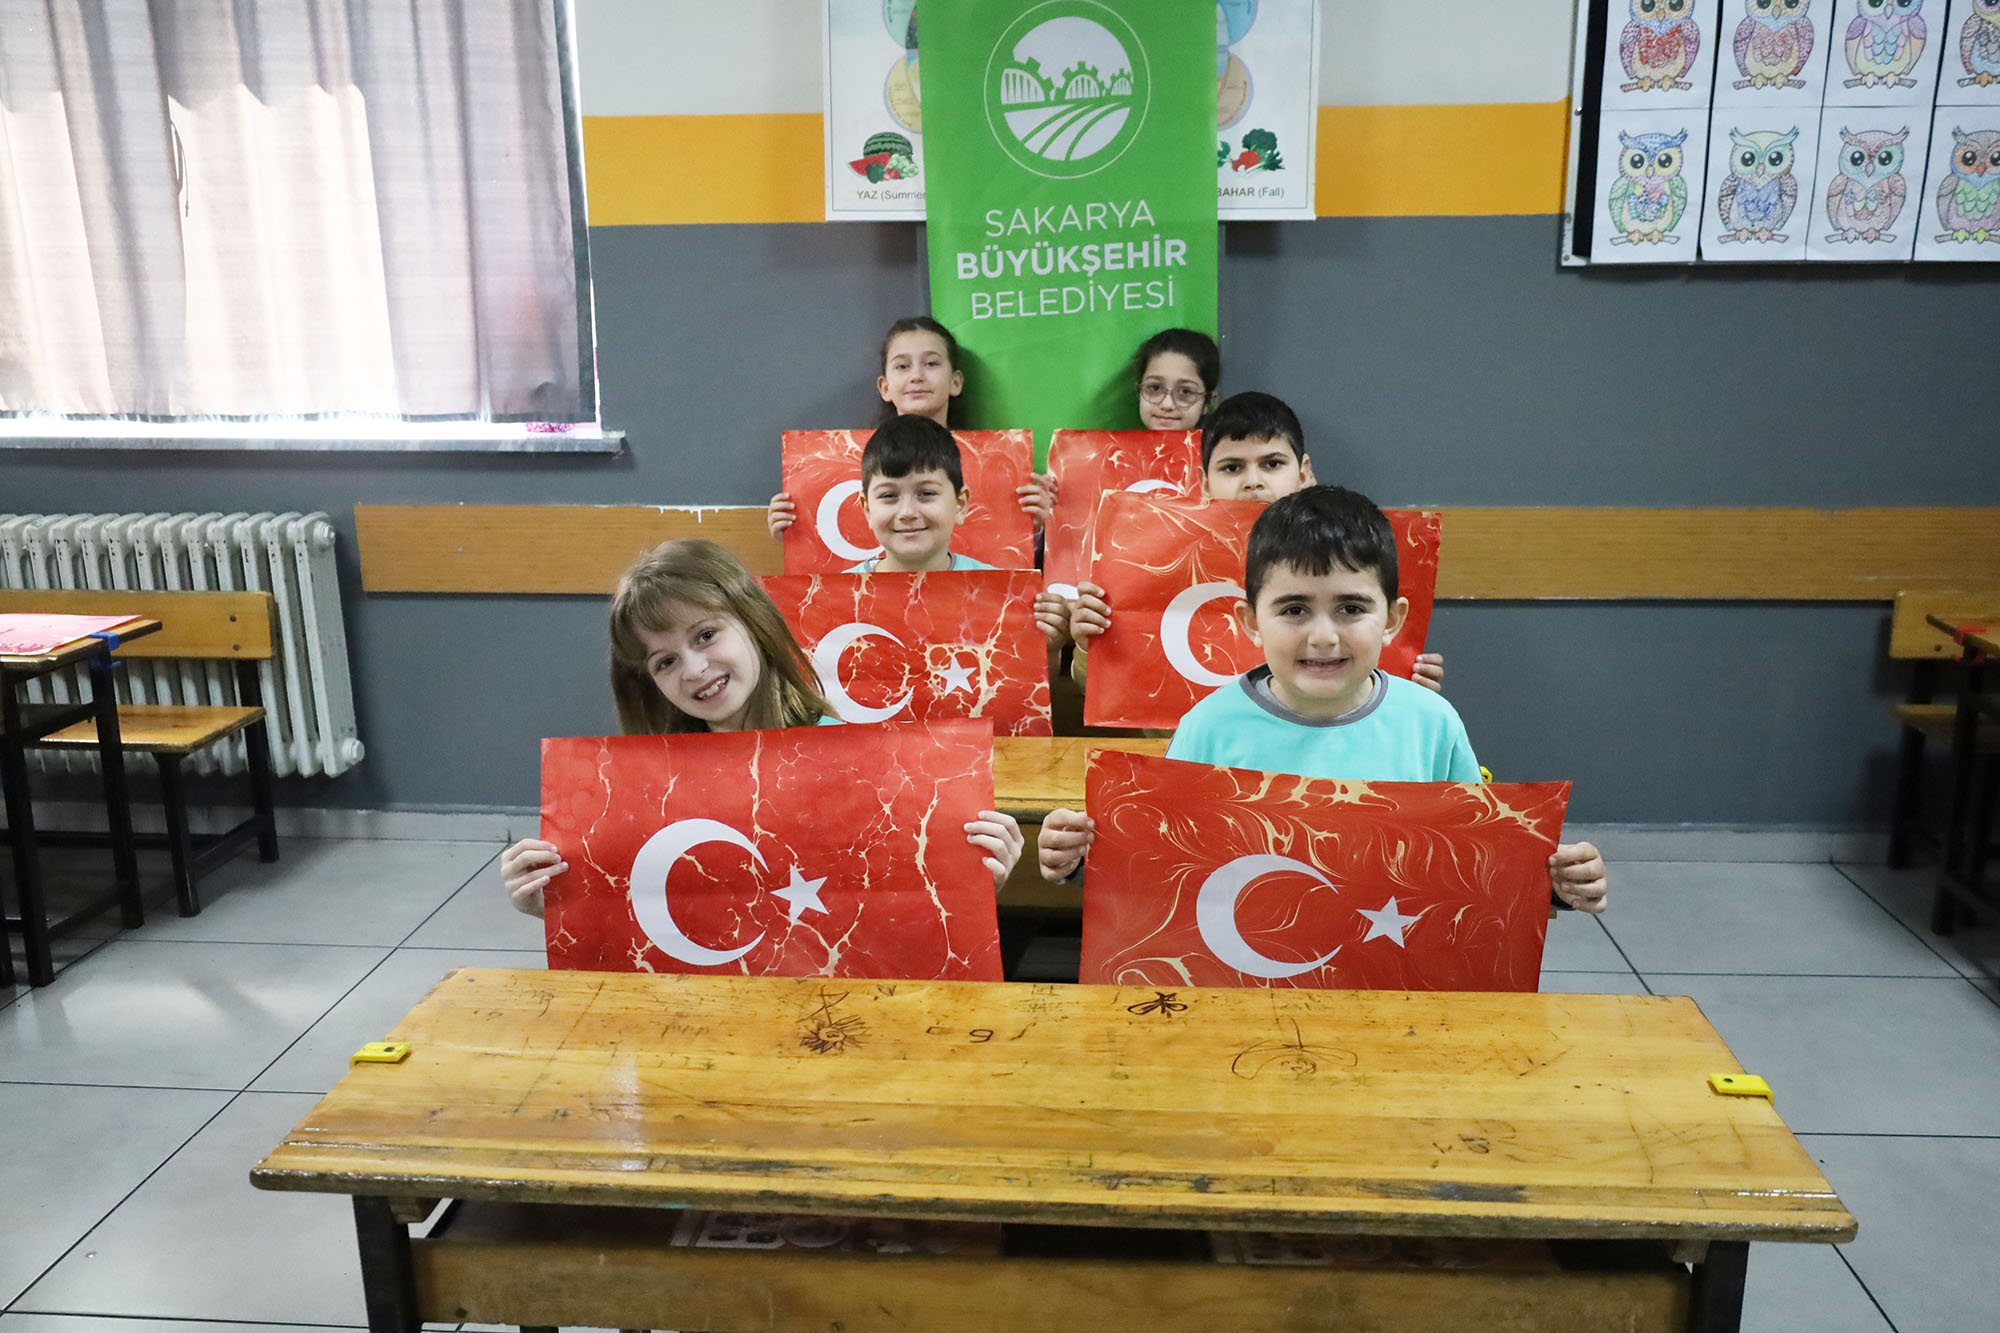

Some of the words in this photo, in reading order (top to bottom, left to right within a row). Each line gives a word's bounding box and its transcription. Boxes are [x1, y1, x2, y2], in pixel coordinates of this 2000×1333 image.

[856, 190, 878, 200] YAZ
[1257, 186, 1285, 199] (Fall)
[984, 199, 1157, 238] SAKARYA
[956, 233, 1188, 280] BÜYÜKŞEHİR
[970, 274, 1175, 321] BELEDİYESİ
